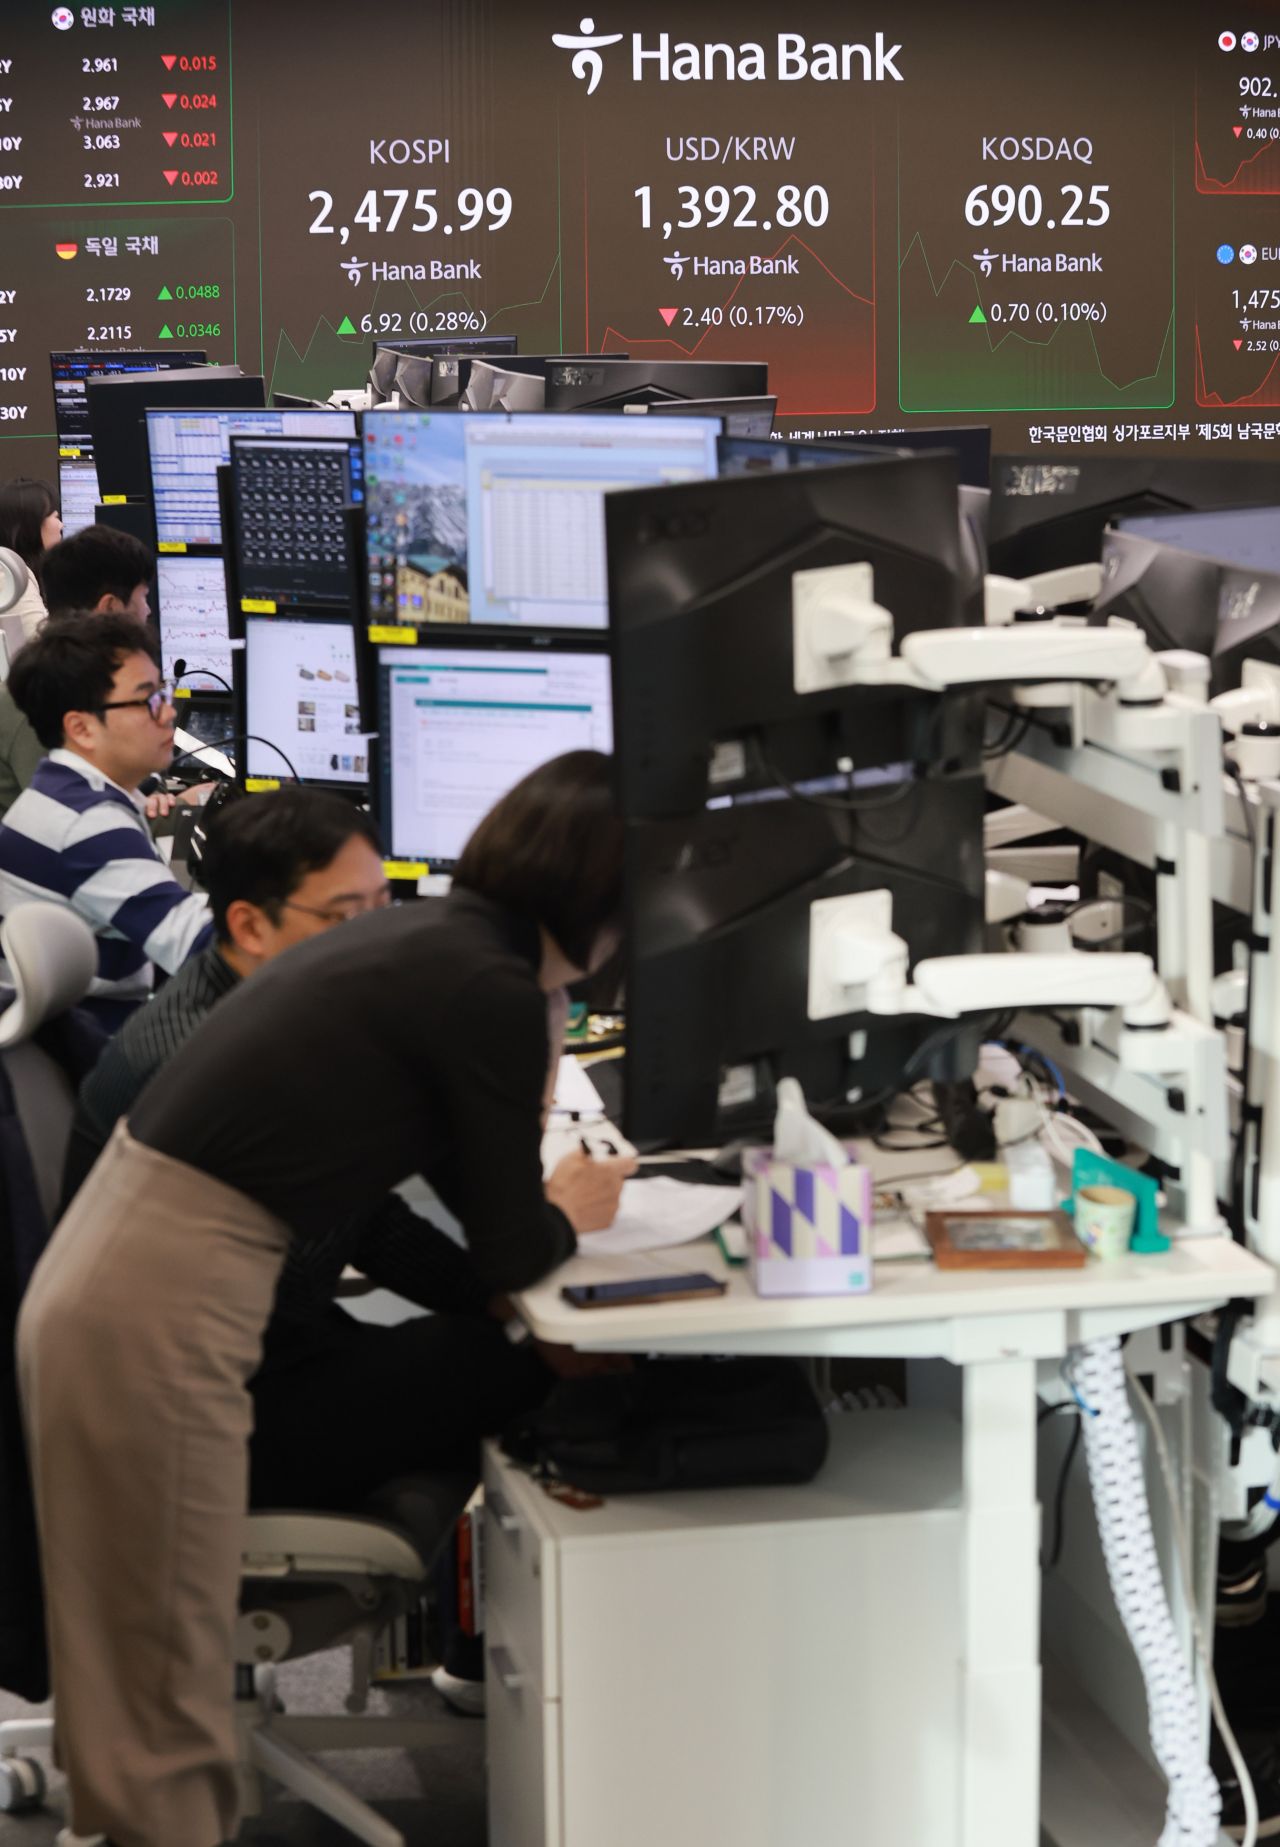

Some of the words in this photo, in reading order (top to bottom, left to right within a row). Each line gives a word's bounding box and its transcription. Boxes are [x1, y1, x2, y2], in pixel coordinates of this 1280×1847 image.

[81, 8, 115, 27] 원화
[122, 7, 154, 26] 국채
[83, 58, 117, 72] 2.961
[180, 56, 216, 71] 0.015
[633, 33, 765, 80] Hana
[778, 32, 904, 80] Bank
[83, 96, 119, 111] 2.967
[180, 94, 216, 109] 0.024
[1253, 108, 1276, 117] Hana
[86, 119, 113, 128] Hana
[115, 117, 141, 128] Bank
[84, 135, 120, 149] 3.063
[181, 133, 215, 147] 0.021
[1247, 128, 1267, 138] 0.40
[371, 140, 449, 164] KOSPI
[667, 136, 795, 163] USD/KRW
[983, 137, 1092, 164] KOSDAQ
[85, 174, 119, 188] 2.921
[182, 171, 217, 185] 0.002
[309, 188, 512, 244] 2,475.99
[635, 185, 828, 239] 1,392.80
[965, 185, 1109, 229] 690.25
[85, 237, 117, 256] 독일
[126, 236, 158, 255] 국채
[1262, 248, 1280, 260] EU
[372, 262, 425, 280] Hana
[431, 260, 481, 279] Bank
[694, 257, 745, 275] Hana
[750, 255, 799, 274] Bank
[1003, 254, 1051, 272] Hana
[1056, 253, 1102, 271] Bank
[0, 291, 16, 304] 2Y
[87, 288, 130, 302] 2.1729
[176, 285, 219, 299] 0.0488
[1233, 290, 1280, 312] 1,475
[361, 314, 401, 333] 6.92
[410, 311, 486, 333] (0.28%)
[683, 307, 722, 326] 2.40
[730, 305, 803, 327] (0.17%)
[991, 304, 1029, 322] 0.70
[1036, 302, 1106, 323] (0.10%)
[0, 329, 17, 342] 5Y
[88, 326, 131, 340] 2.2115
[177, 324, 220, 337] 0.0346
[1253, 320, 1276, 329] Hana
[1248, 341, 1266, 351] 2.52
[0, 368, 26, 381] 10Y
[0, 406, 27, 419] 30Y
[1029, 425, 1106, 443] 한국문인협회
[1113, 424, 1190, 442] 싱가포르지부
